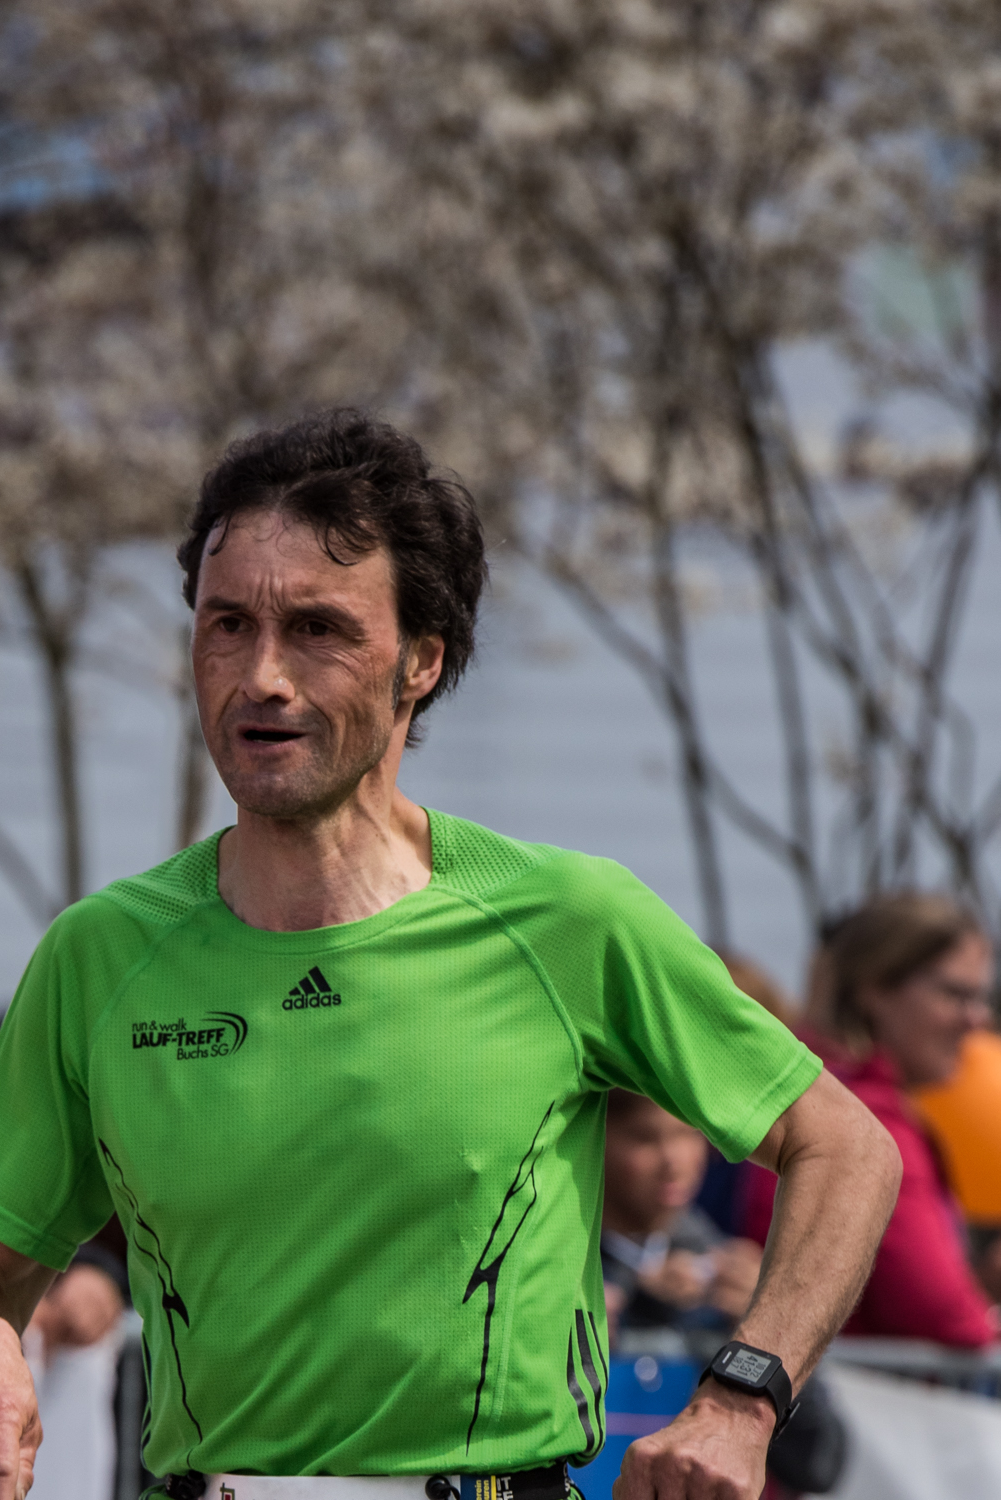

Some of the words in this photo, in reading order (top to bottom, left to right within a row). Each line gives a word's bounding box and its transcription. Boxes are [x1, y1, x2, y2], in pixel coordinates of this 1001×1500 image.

[281, 993, 342, 1011] adidas
[132, 1022, 148, 1032] run
[148, 1020, 158, 1031] &
[159, 1017, 187, 1032] walk
[132, 1027, 226, 1050] LAUF-TREFF
[177, 1044, 209, 1061] Buchs
[210, 1043, 229, 1058] SG
